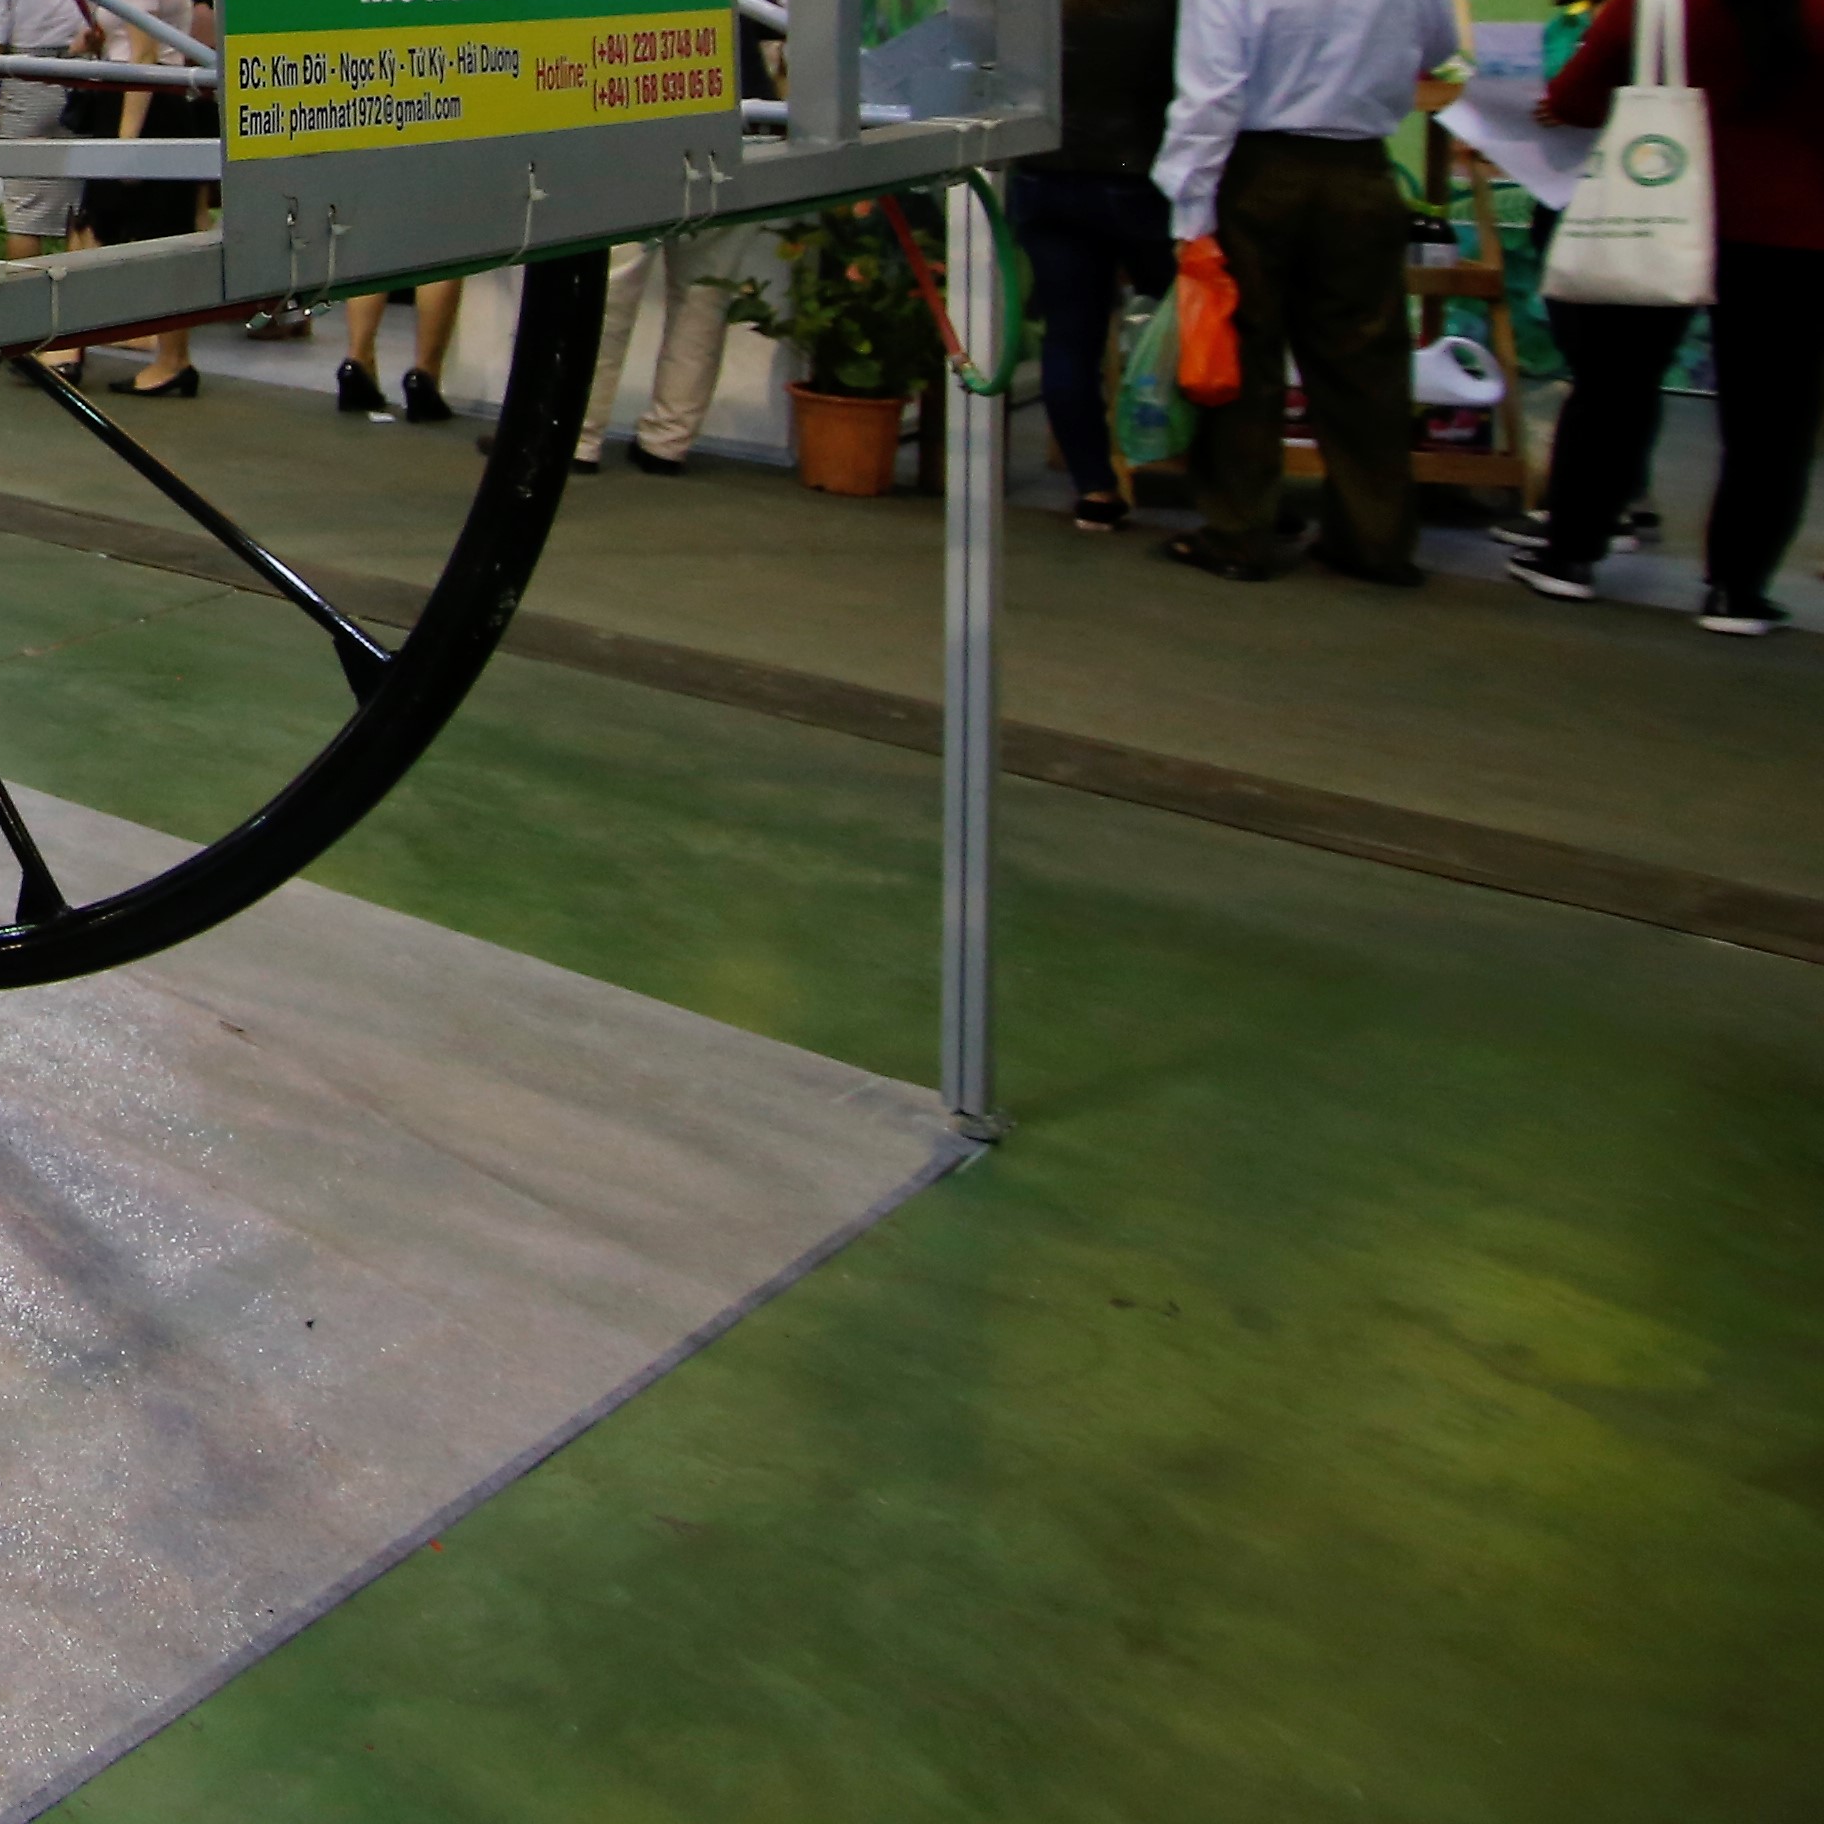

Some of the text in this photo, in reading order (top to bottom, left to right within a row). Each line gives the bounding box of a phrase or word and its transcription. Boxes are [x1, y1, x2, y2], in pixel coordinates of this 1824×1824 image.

[593, 33, 628, 69] (+84)
[239, 57, 267, 89] ĐC:
[271, 55, 298, 87] Kim
[340, 51, 374, 90] Ngọc
[536, 55, 588, 91] Hotline:
[593, 76, 630, 112] (+84)
[239, 91, 462, 141] Email: phamhat1972@gmail.com
